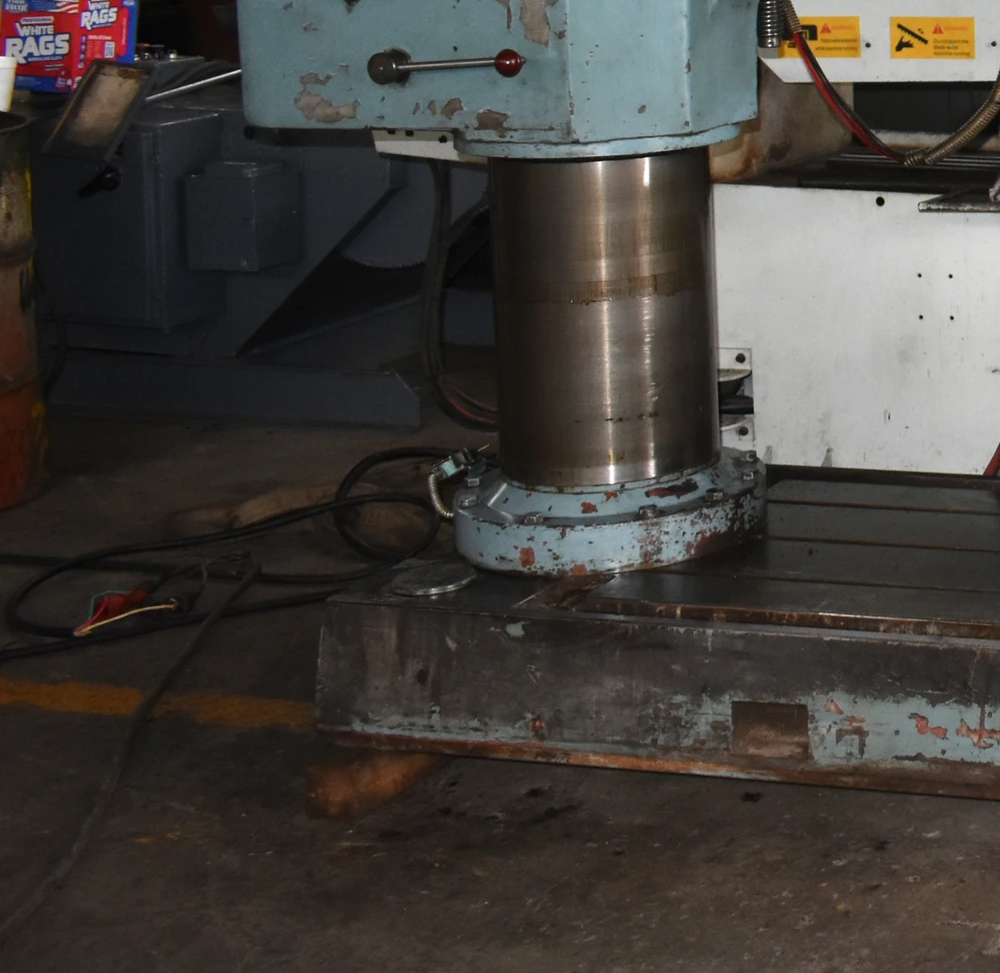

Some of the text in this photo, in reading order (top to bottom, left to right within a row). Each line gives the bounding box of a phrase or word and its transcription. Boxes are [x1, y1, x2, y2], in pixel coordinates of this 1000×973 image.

[88, 1, 110, 11] WHITE
[81, 7, 118, 30] RAGS
[15, 22, 54, 36] WHITE
[5, 33, 70, 64] RAGS
